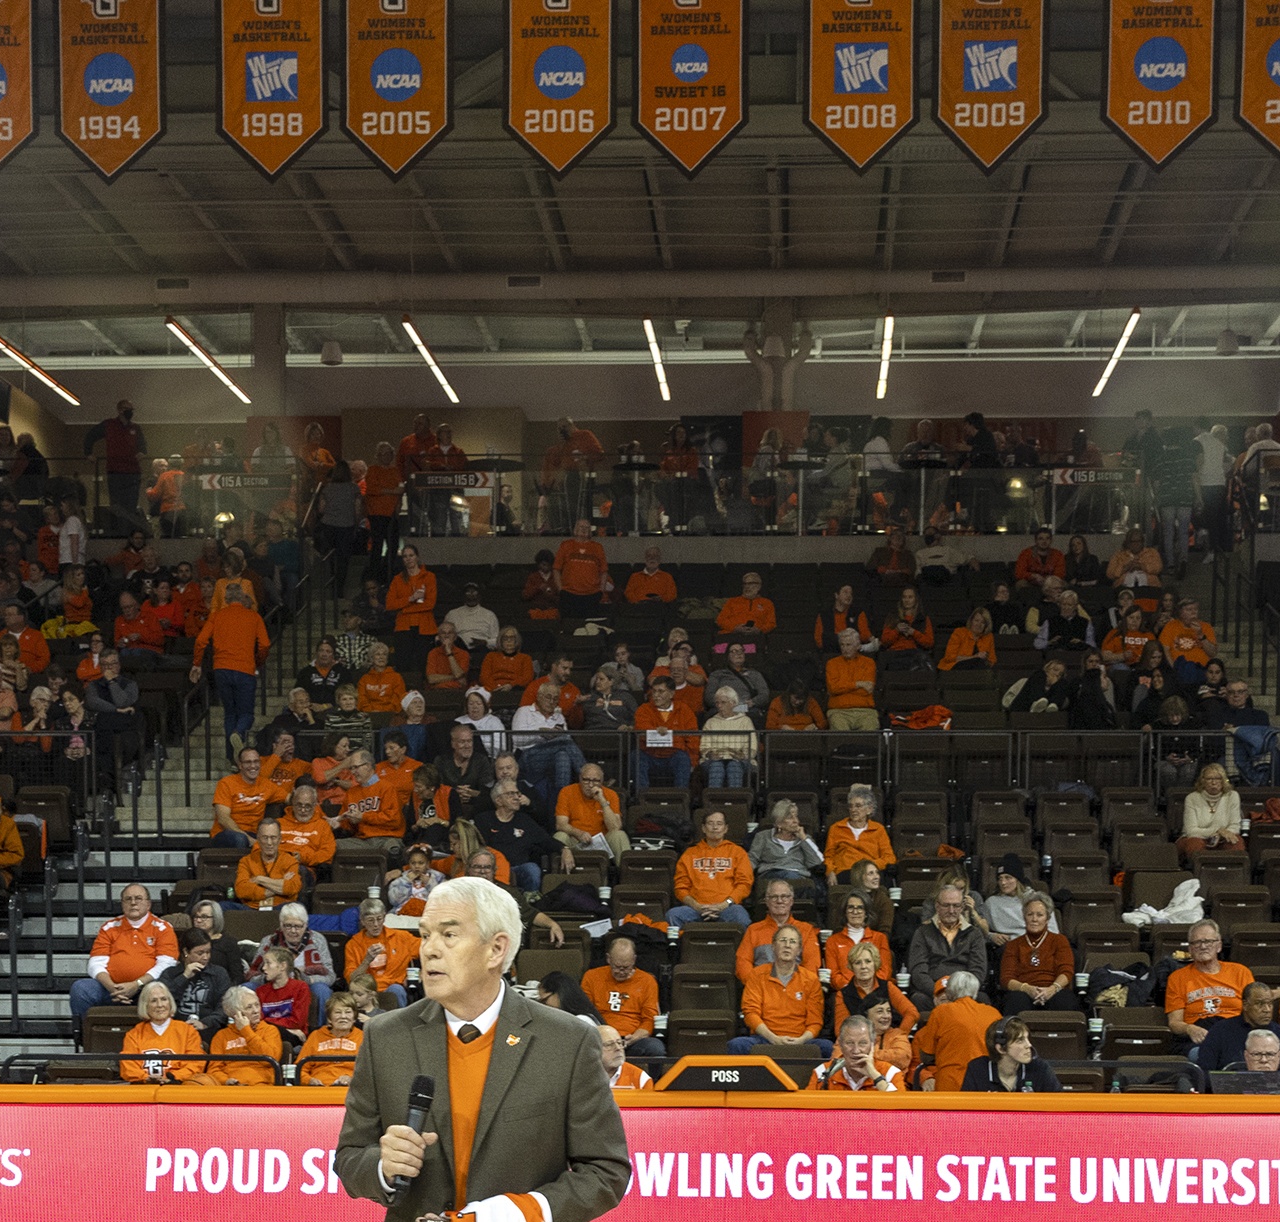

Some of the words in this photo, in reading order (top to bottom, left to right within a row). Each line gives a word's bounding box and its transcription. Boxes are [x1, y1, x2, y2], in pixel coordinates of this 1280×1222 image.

[1133, 5, 1193, 17] WOMEN'S
[368, 17, 426, 29] WOMEN'S
[531, 16, 589, 27] WOMEN'S
[661, 13, 720, 24] WOMEN'S
[951, 18, 1032, 31] BASKETBALL
[1122, 17, 1203, 29] BASKETBALL
[80, 22, 138, 34] WOMEN'S
[242, 20, 301, 32] WOMEN'S
[521, 26, 600, 38] BASKETBALL
[650, 23, 731, 36] BASKETBALL
[821, 21, 902, 33] BASKETBALL
[71, 34, 148, 45] BASKETBALL
[232, 31, 310, 42] BASKETBALL
[358, 29, 435, 41] BASKETBALL
[674, 62, 708, 75] NCAA
[1138, 62, 1186, 78] NCAA
[375, 74, 421, 89] NCAA
[538, 71, 585, 87] NCAA
[89, 78, 134, 94] NCAA
[655, 86, 708, 98] SWEET
[712, 85, 726, 97] 16
[654, 106, 727, 131] 2007
[825, 105, 897, 129] 2008
[954, 102, 1026, 128] 2009
[1127, 100, 1192, 125] 2010
[78, 115, 141, 140] 1994
[241, 112, 303, 137] 1998
[361, 110, 431, 136] 2005
[523, 109, 595, 134] 2006
[453, 474, 467, 485] 115
[1074, 471, 1087, 482] 115
[711, 1069, 740, 1083] POSS
[146, 1148, 291, 1193] PROUD
[624, 1152, 773, 1199] WLING
[785, 1154, 924, 1200] GREEN
[935, 1156, 1057, 1202] STATE
